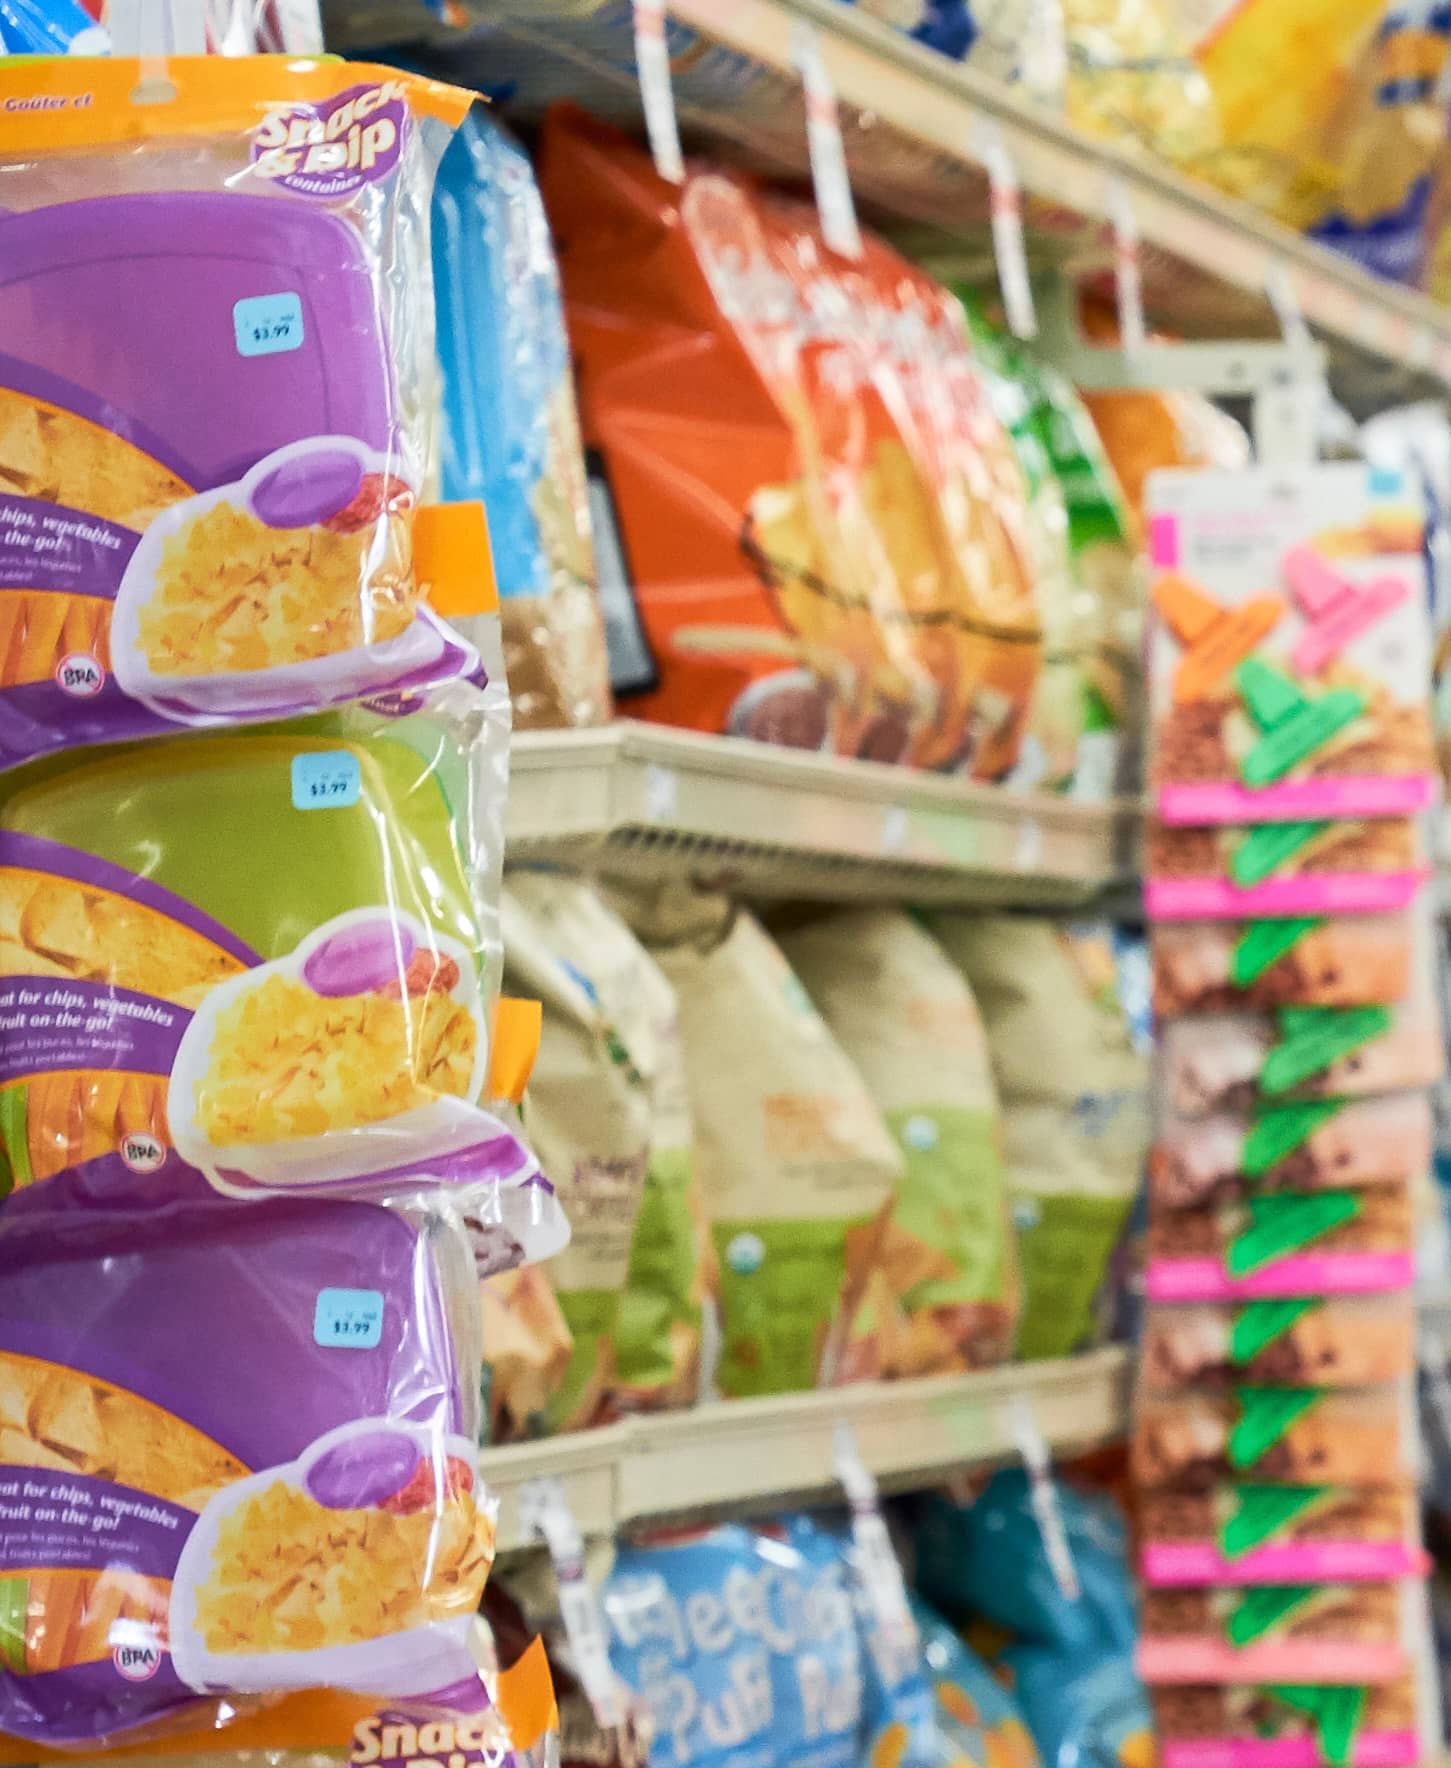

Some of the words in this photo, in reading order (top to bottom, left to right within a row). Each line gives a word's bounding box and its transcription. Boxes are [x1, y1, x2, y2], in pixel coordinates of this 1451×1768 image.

[303, 117, 396, 172] Dip
[0, 505, 37, 529] hips,
[43, 515, 122, 551] vegetables
[94, 996, 174, 1028] vegetables
[100, 1495, 179, 1530] vegetables
